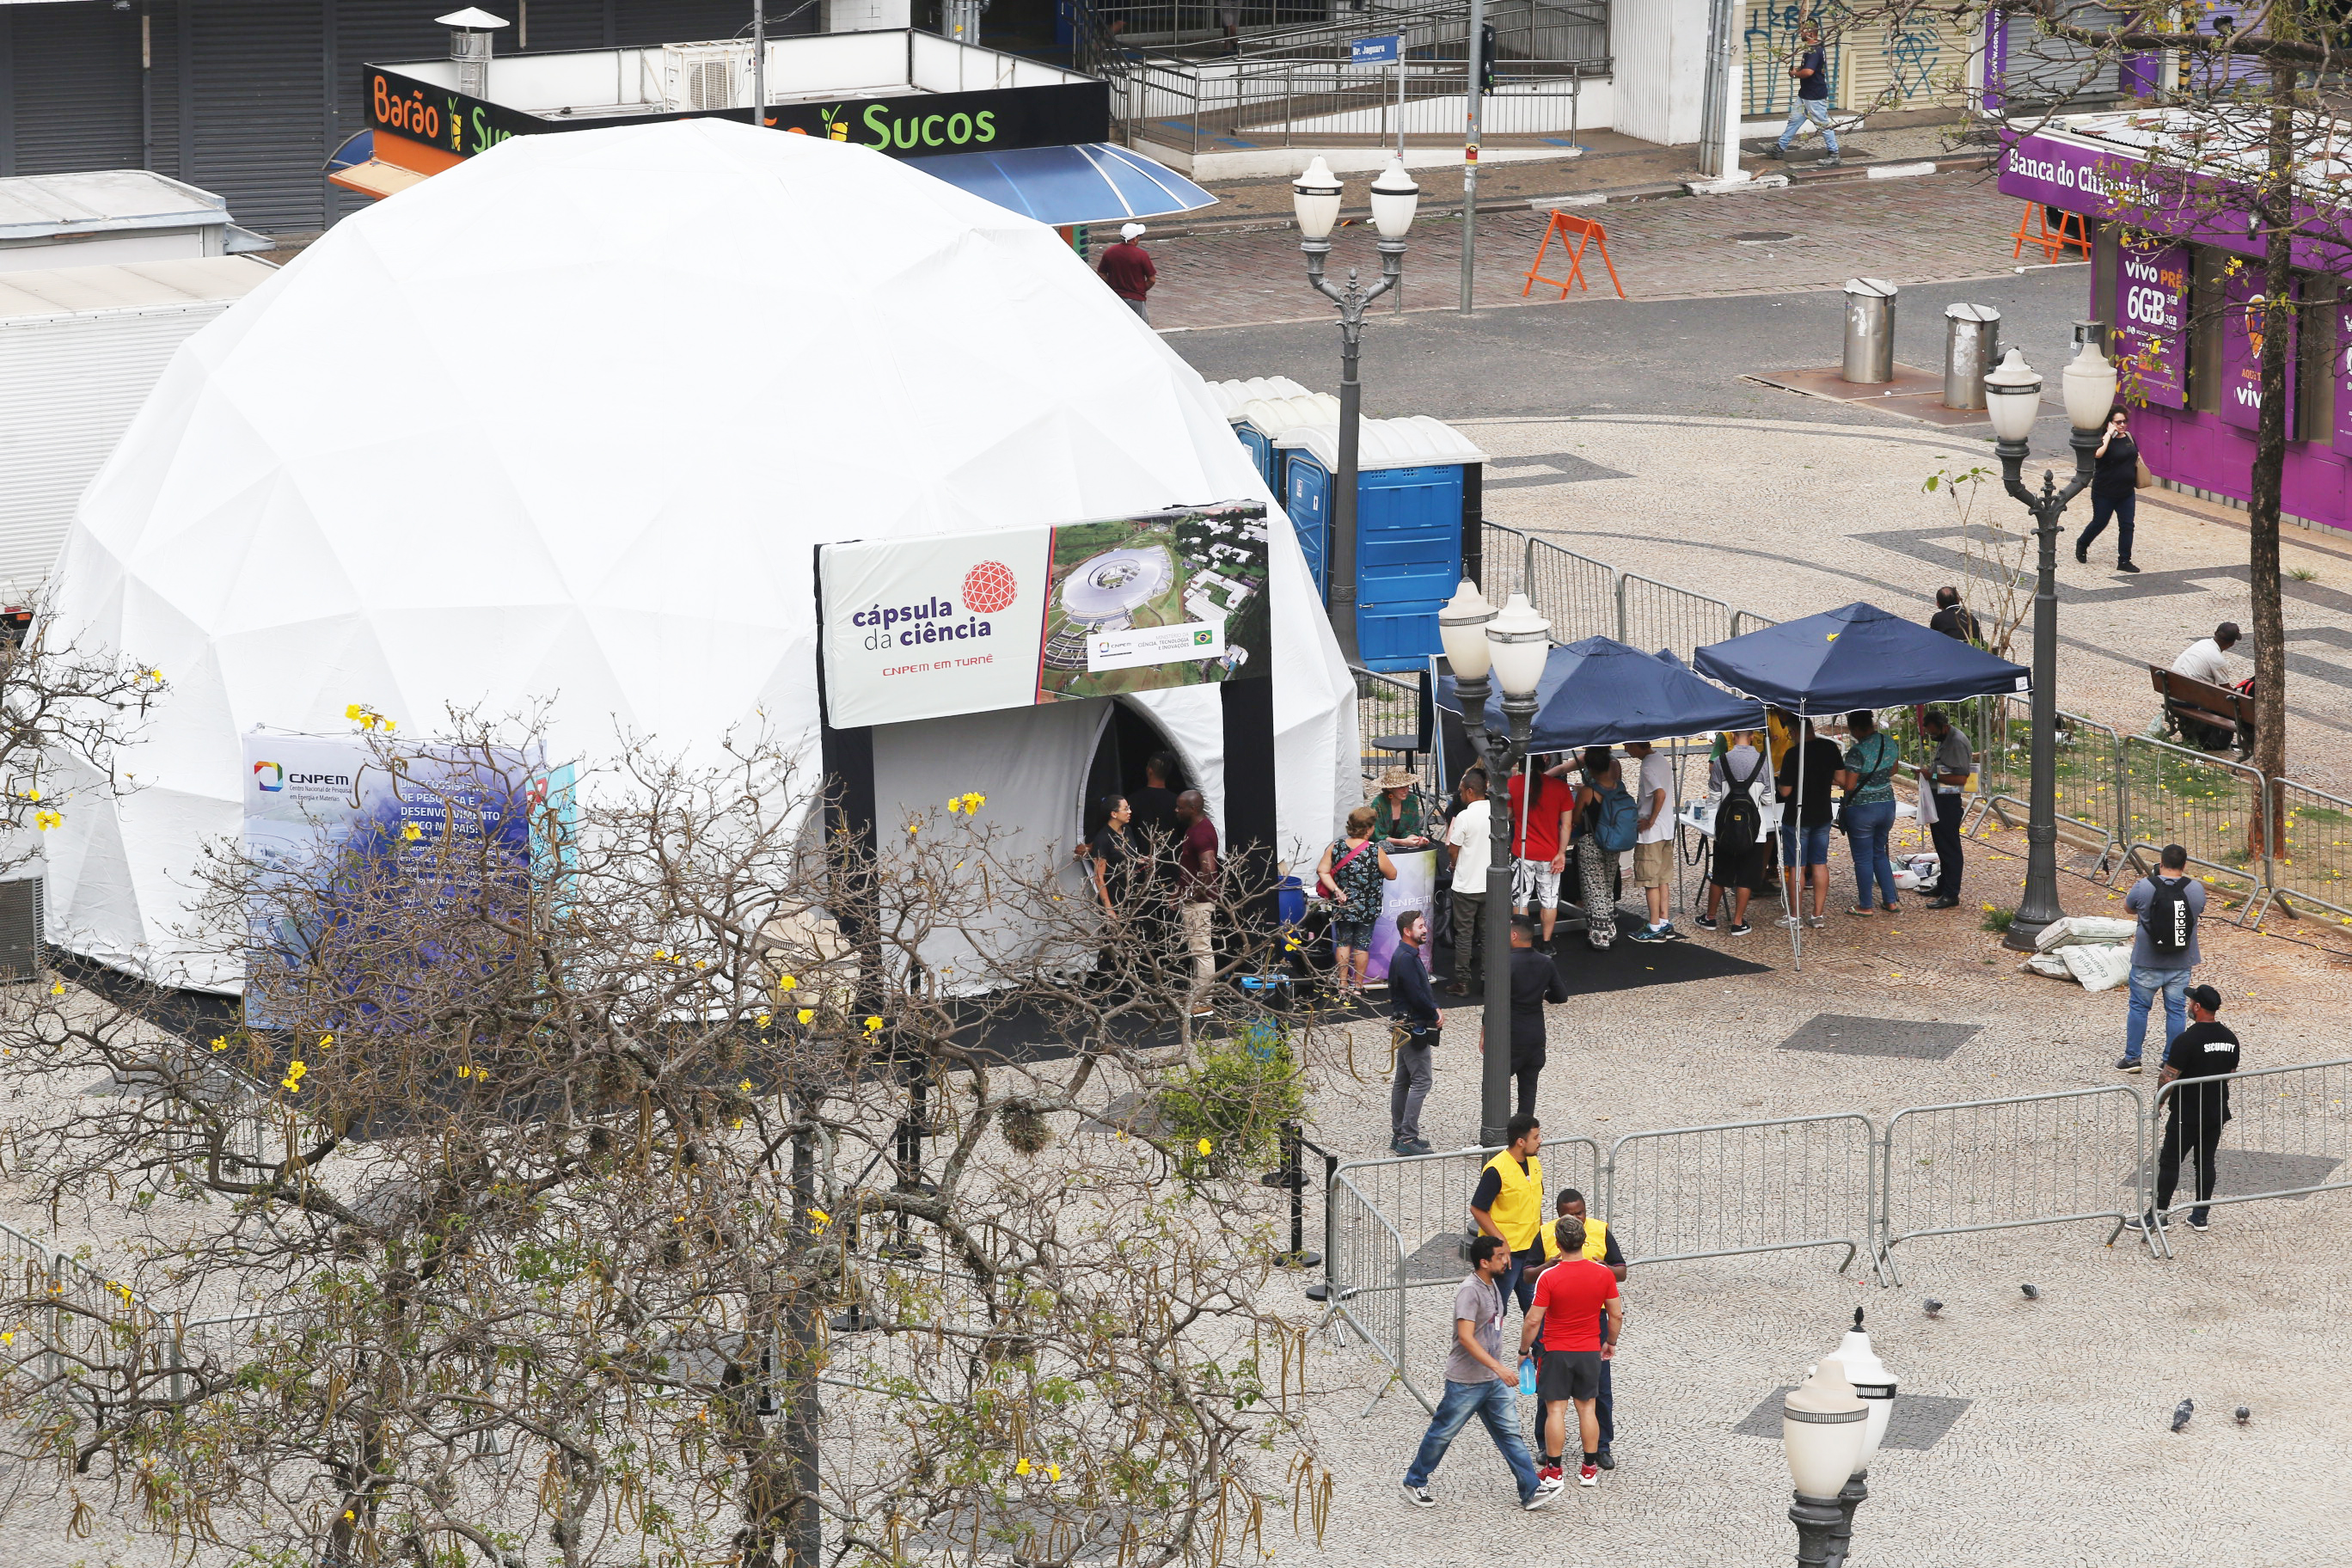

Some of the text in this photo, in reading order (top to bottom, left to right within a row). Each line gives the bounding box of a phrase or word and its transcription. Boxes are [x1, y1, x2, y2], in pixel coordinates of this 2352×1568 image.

[1363, 45, 1385, 55] Jaguara
[374, 75, 439, 138] Barão
[863, 104, 995, 151] Sucos
[2009, 149, 2055, 183] Banca
[2056, 160, 2074, 188] do
[2125, 255, 2184, 289] vivo PRÉ
[2128, 285, 2165, 325] 6GB
[2166, 294, 2178, 305] 3GB
[2165, 315, 2177, 325] 3GB
[2236, 381, 2263, 408] viv
[853, 597, 952, 630] cápsula
[864, 616, 991, 651] da ciência
[882, 653, 994, 677] CNPEM EM TURNÊ
[289, 773, 349, 786] CNPEM
[400, 779, 417, 788] UM
[401, 793, 414, 802] DE
[469, 796, 475, 805] E
[1389, 895, 1431, 908] CNPEM
[2175, 903, 2186, 944] adidas
[2077, 954, 2096, 975] Argila
[2079, 946, 2109, 978] Expandida
